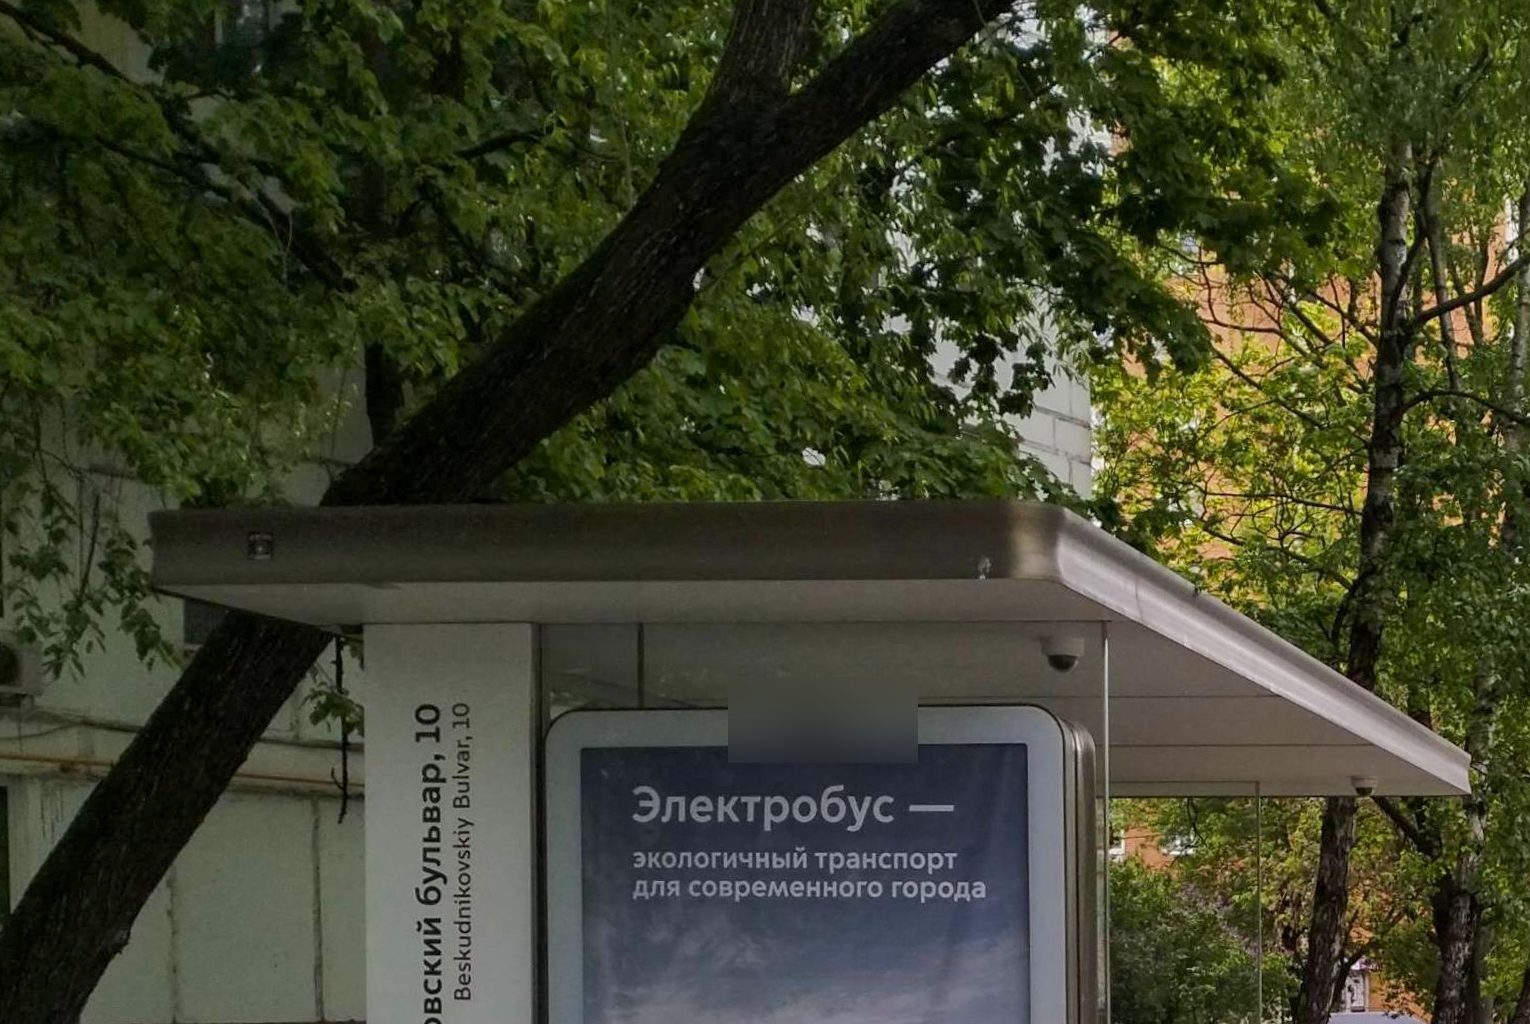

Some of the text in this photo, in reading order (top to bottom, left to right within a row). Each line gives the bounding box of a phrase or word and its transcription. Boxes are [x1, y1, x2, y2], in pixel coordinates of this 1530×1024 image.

[414, 703, 442, 744] 10
[414, 753, 448, 906] бульвар,
[632, 784, 895, 832] Электробус
[452, 702, 474, 1001] Beskudnikovskiy Bulvar, 10
[633, 846, 958, 874] экологичный транспорт
[632, 880, 987, 905] для современного города
